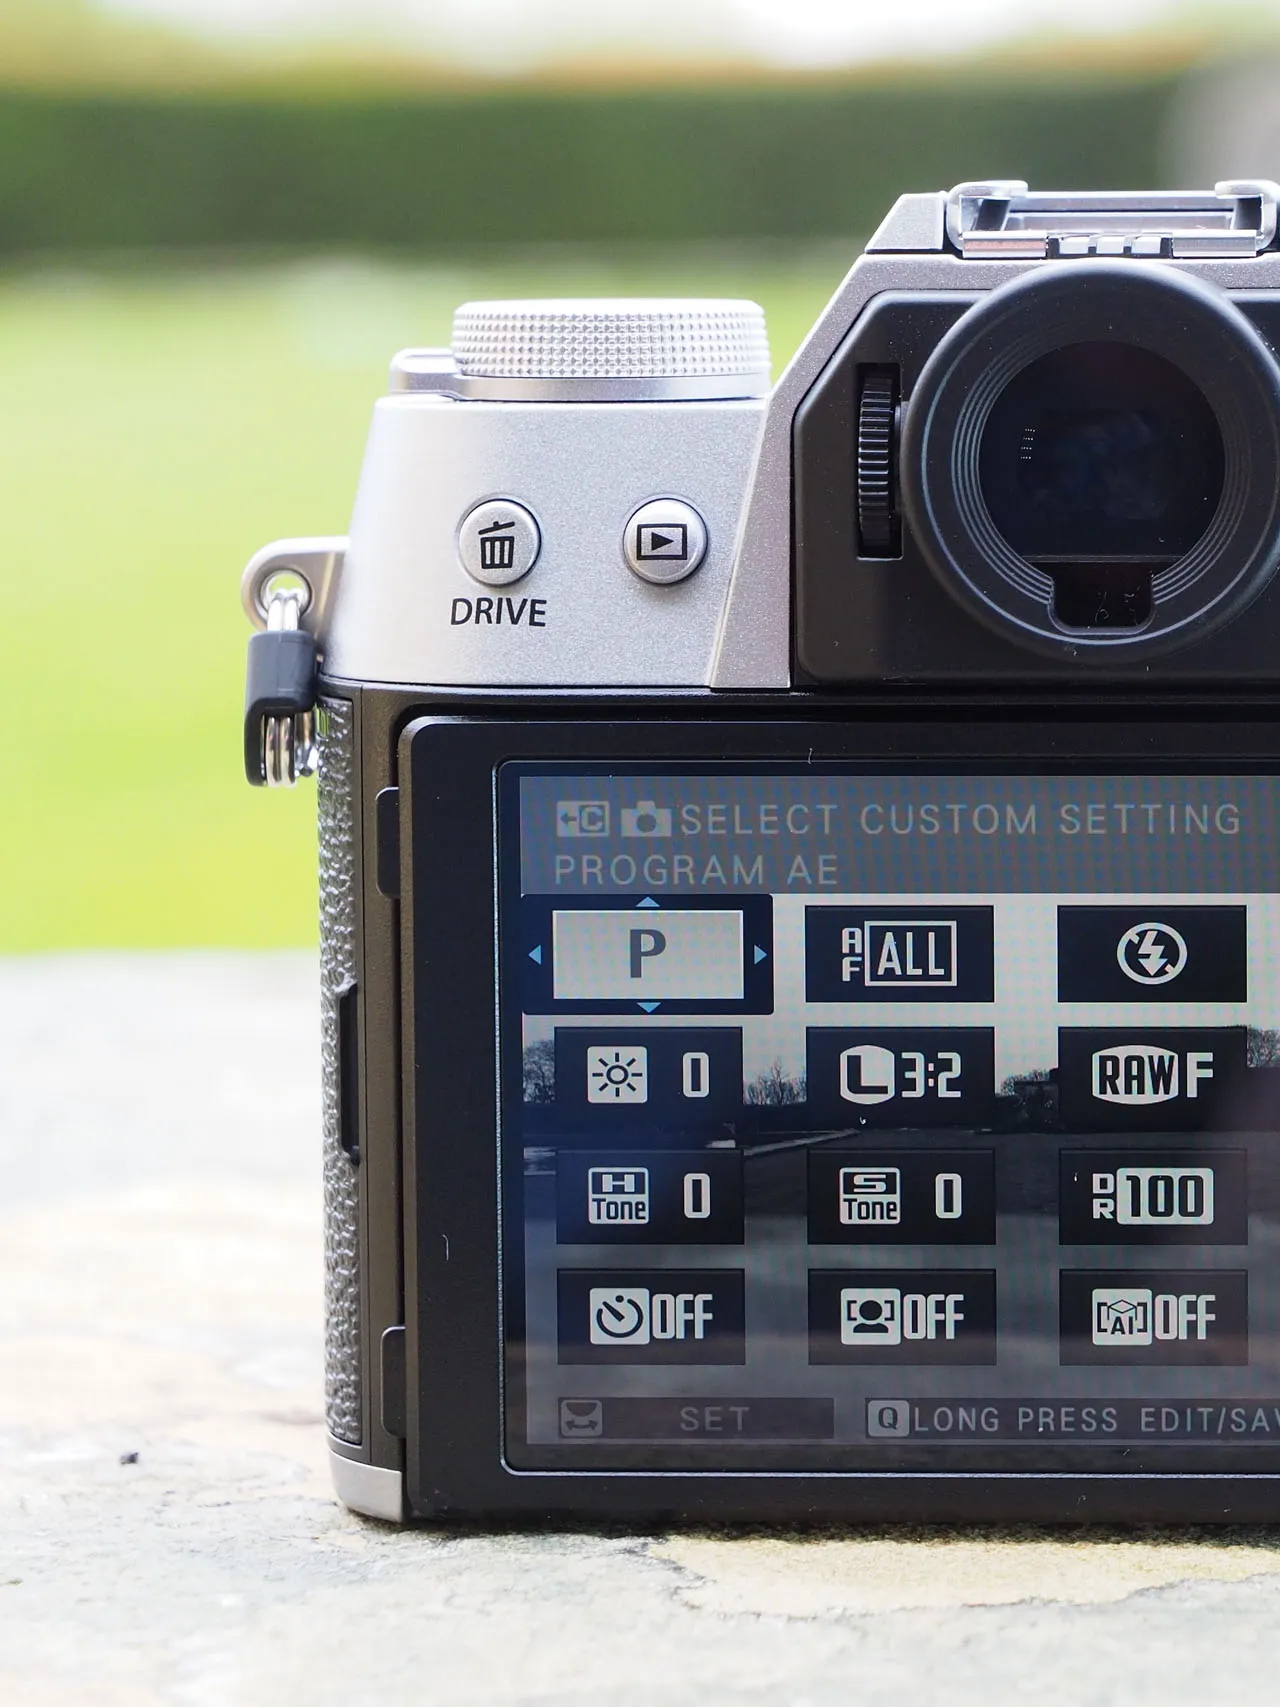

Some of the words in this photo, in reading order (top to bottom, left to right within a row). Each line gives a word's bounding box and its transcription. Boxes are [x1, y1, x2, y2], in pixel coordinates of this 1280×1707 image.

[451, 597, 547, 627] DRIVE
[681, 804, 838, 835] SELECT
[861, 804, 1036, 835] CUSTOM
[1060, 804, 1241, 835] SETTING
[555, 855, 764, 885] PROGRAM
[787, 855, 838, 885] AE
[629, 928, 667, 978] P
[877, 932, 944, 975] ALL
[683, 1052, 709, 1098] 0
[902, 1052, 962, 1098] 3:2
[1098, 1055, 1175, 1095] RAW
[1186, 1052, 1214, 1098] F
[602, 1174, 636, 1192] H
[683, 1173, 710, 1219] 0
[853, 1174, 887, 1192] S
[935, 1173, 962, 1219] 0
[1126, 1174, 1205, 1218] 100
[592, 1198, 646, 1220] Tone
[843, 1198, 898, 1220] Tone
[652, 1293, 713, 1340] OFF
[903, 1293, 964, 1340] OFF
[1154, 1294, 1216, 1340] OFF
[680, 1407, 750, 1431] SET
[878, 1407, 898, 1430] Q
[915, 1407, 999, 1431] LONG
[1017, 1407, 1118, 1433] PRESS
